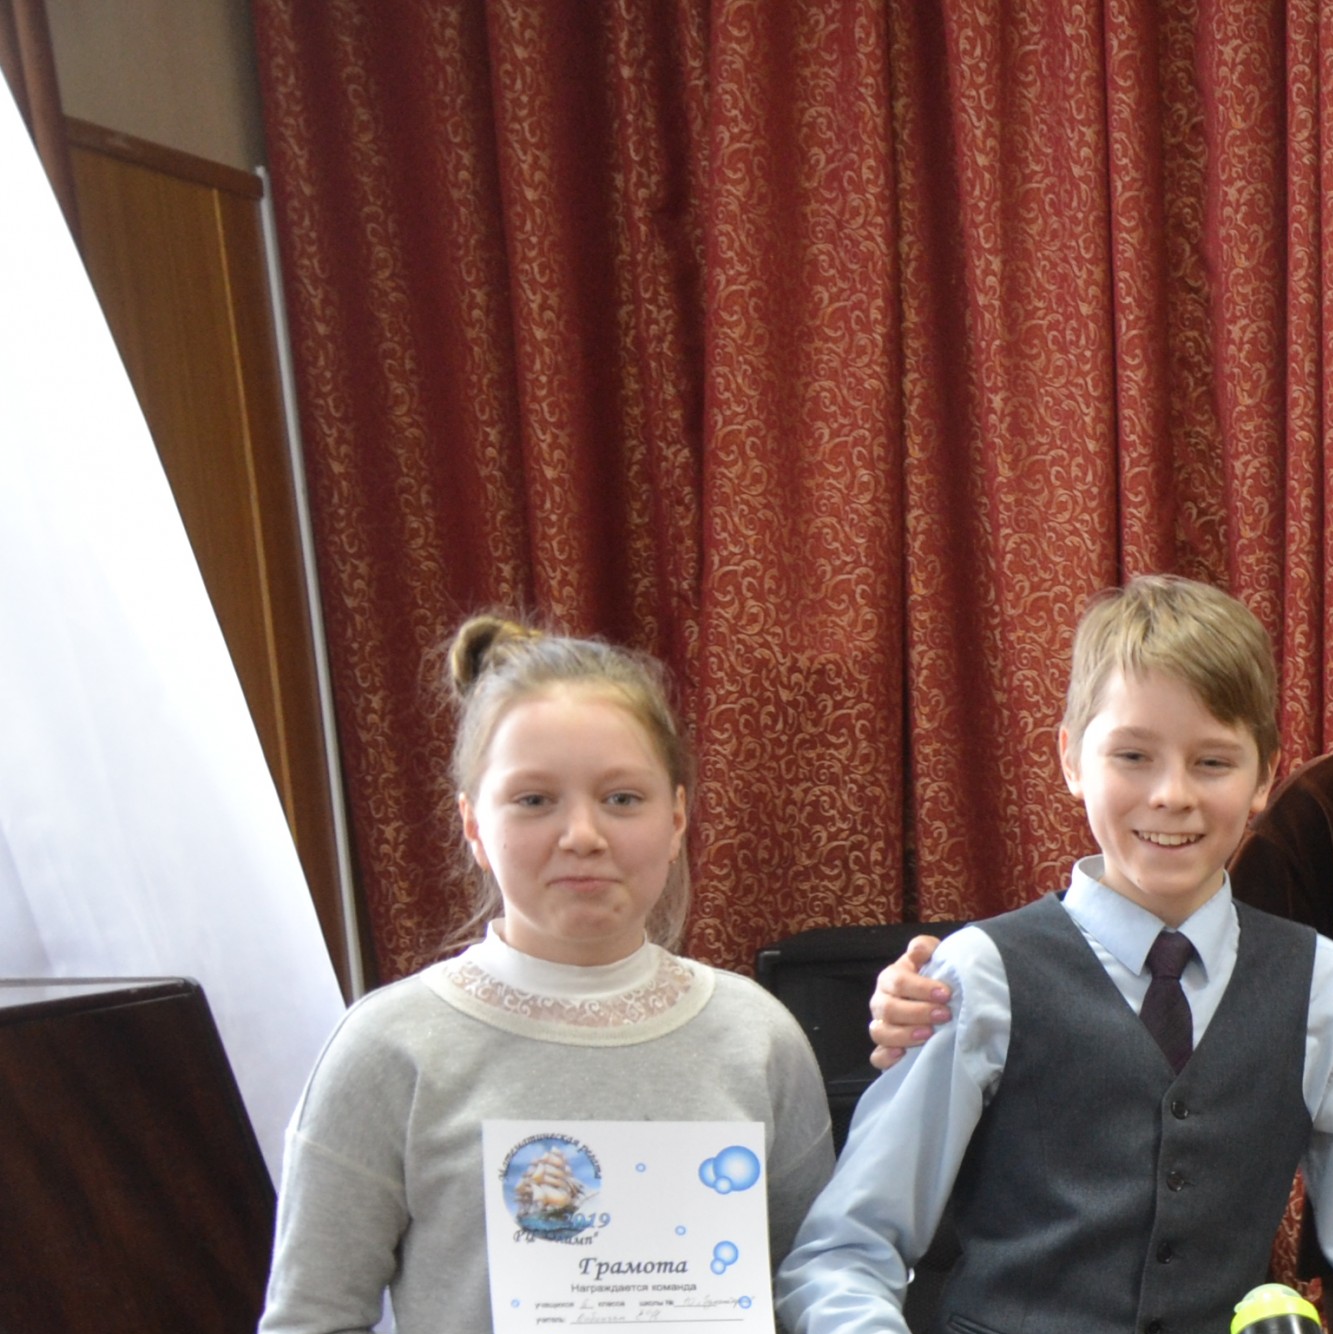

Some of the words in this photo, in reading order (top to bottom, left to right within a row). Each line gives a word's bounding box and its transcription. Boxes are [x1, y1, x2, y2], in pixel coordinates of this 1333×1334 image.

[579, 1257, 688, 1280] Грамота
[571, 1283, 648, 1294] Награждается
[652, 1282, 697, 1292] команда
